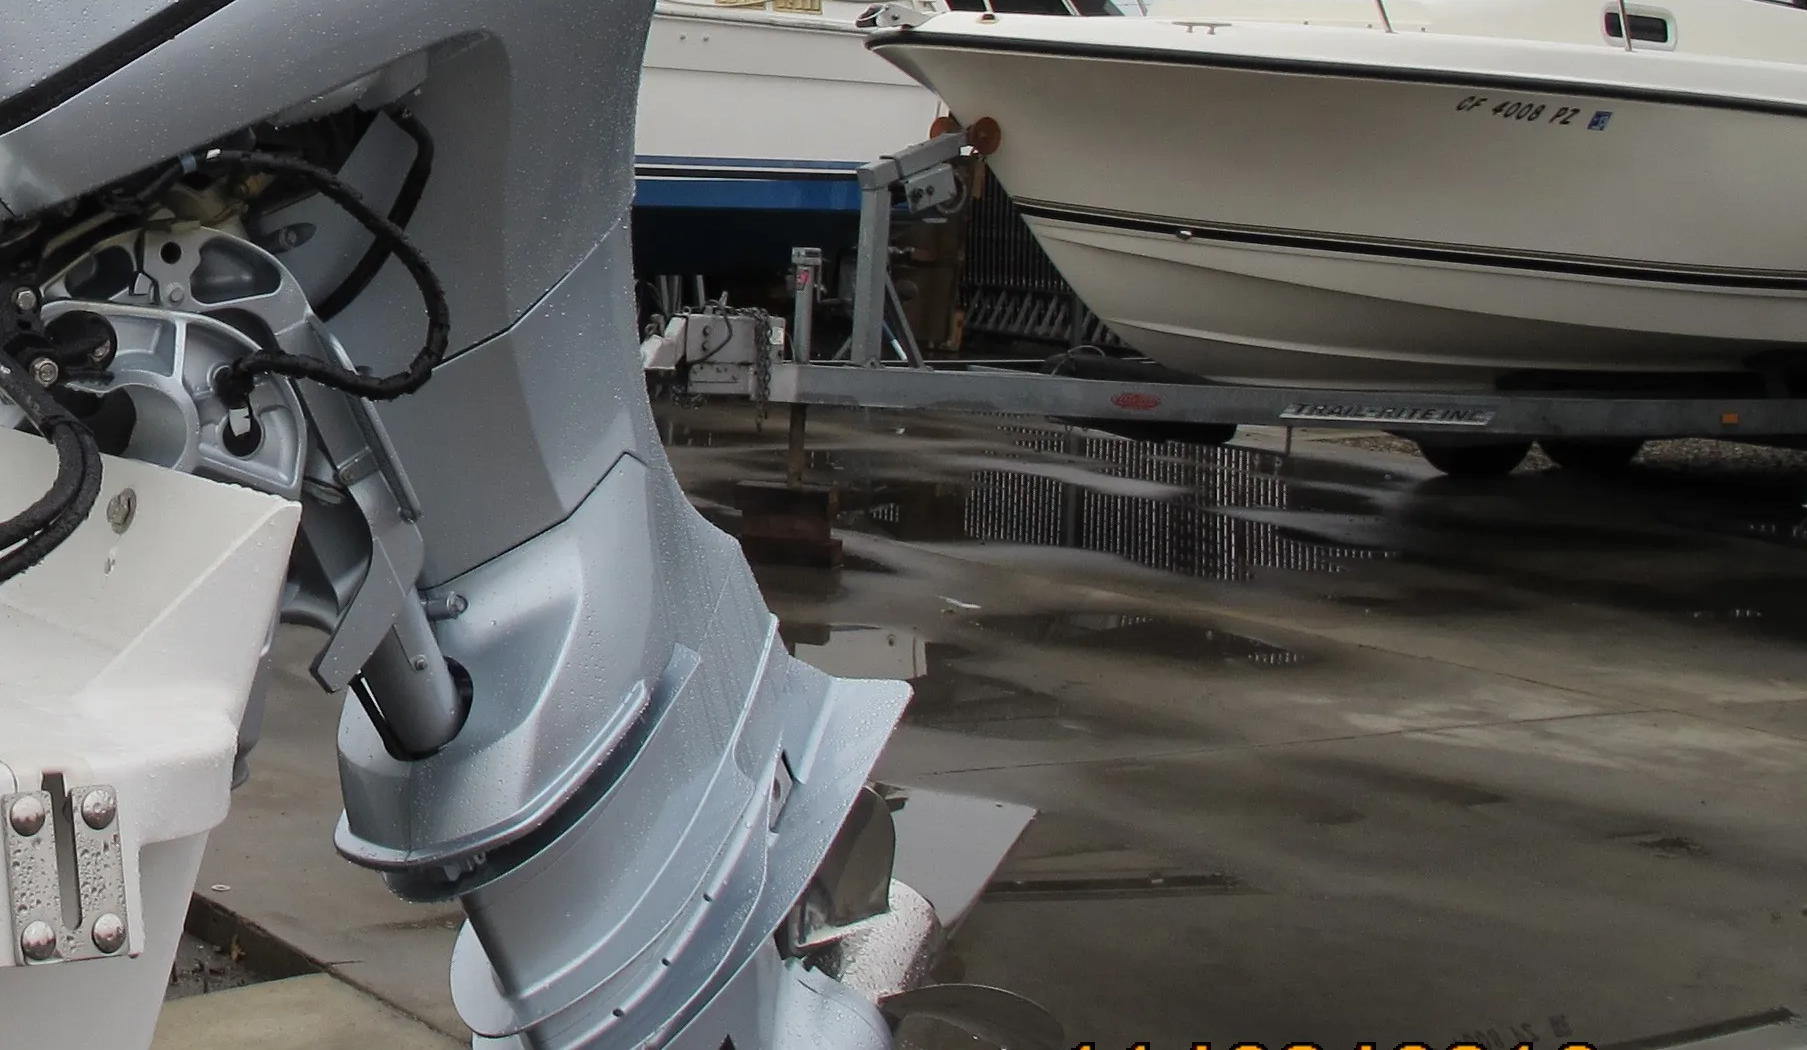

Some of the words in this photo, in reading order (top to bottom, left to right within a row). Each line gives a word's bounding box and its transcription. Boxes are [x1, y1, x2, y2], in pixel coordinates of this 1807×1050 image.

[1456, 96, 1488, 111] CF
[1492, 101, 1546, 122] 4008
[1549, 107, 1581, 125] PZ
